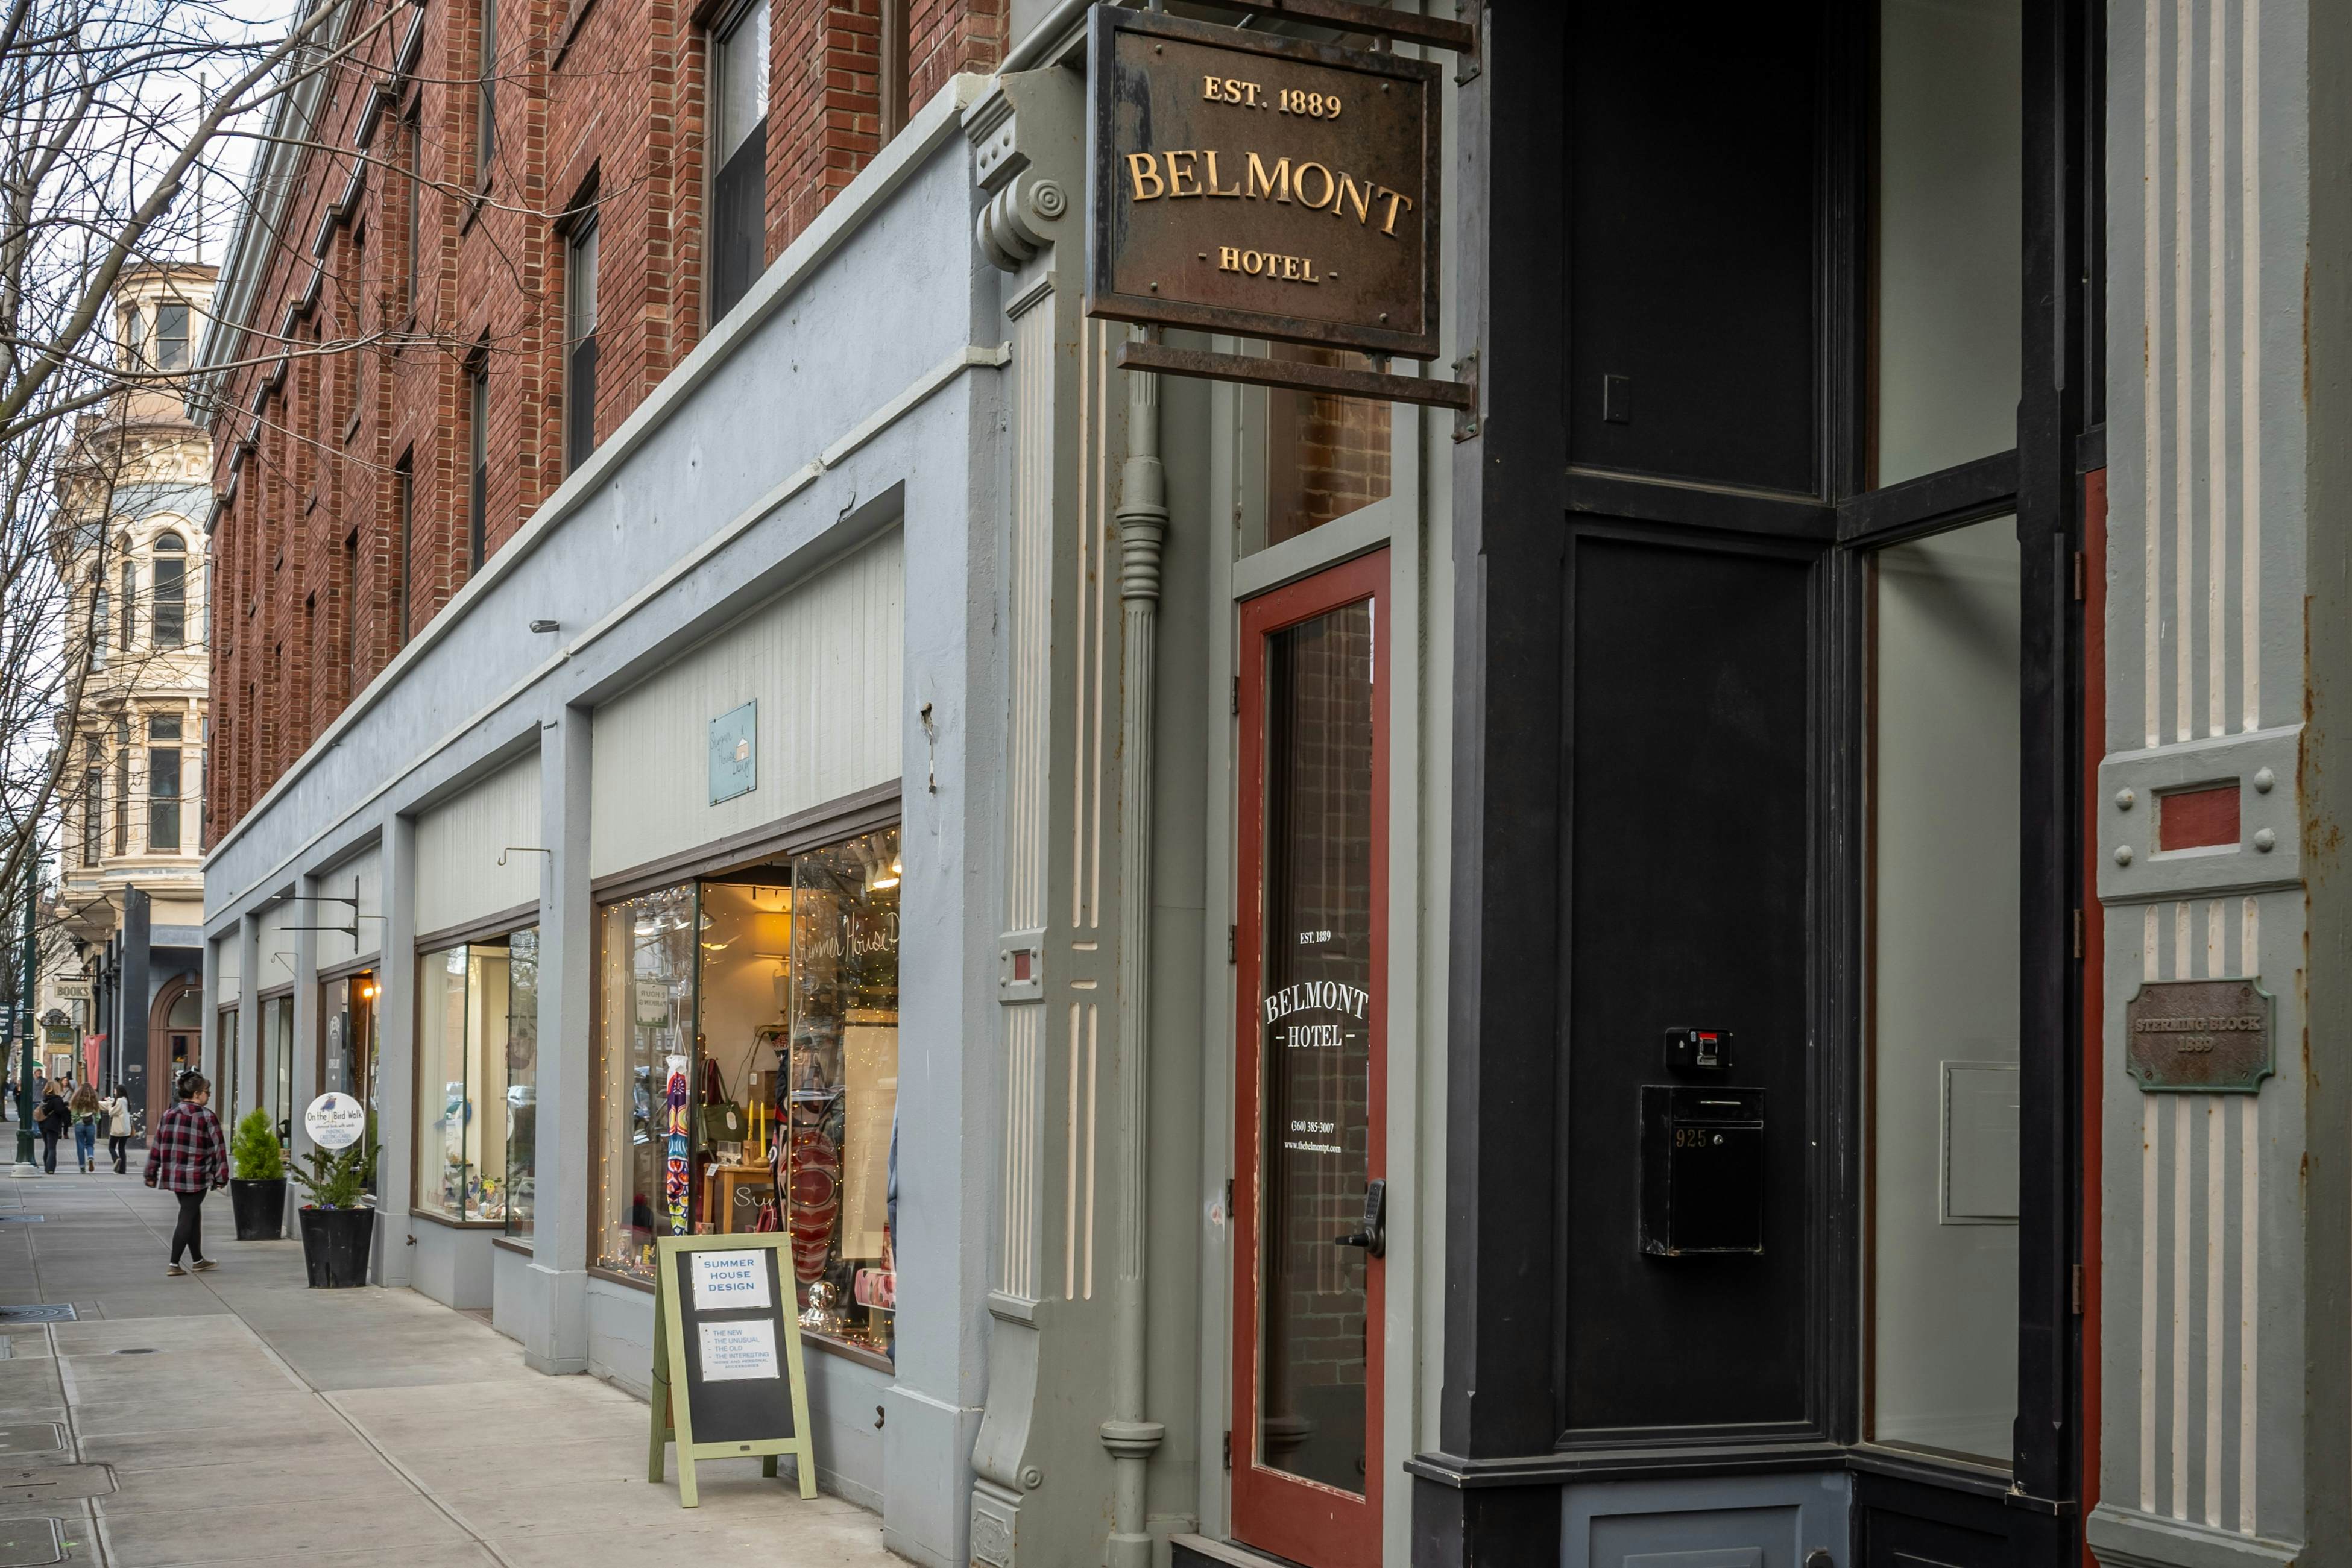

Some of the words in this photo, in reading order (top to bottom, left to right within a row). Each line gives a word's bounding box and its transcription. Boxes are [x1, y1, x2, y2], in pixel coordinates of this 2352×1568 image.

[1203, 75, 1269, 110] EST.
[1278, 87, 1343, 120] 1889
[1124, 149, 1414, 239] BELMONT
[845, 911, 891, 962] House
[1299, 931, 1315, 945] EST.
[1316, 930, 1331, 943] 1889
[57, 987, 89, 996] BOOKS
[1264, 980, 1369, 1025] BELMONT
[2208, 1016, 2261, 1031] BLOCK
[2177, 1036, 2216, 1053] 1889
[307, 1112, 316, 1121] On
[317, 1111, 327, 1121] the
[333, 1110, 346, 1119] Bird
[347, 1109, 362, 1119] Walk
[1291, 1119, 1307, 1133] (360)
[1307, 1121, 1335, 1134] 385-3007
[1676, 1128, 1707, 1148] 925
[1284, 1140, 1342, 1154] www.thebelmontpt.com
[704, 1259, 754, 1268] SUMMER
[710, 1271, 751, 1280] HOUSE
[708, 1282, 755, 1292] DESIGN
